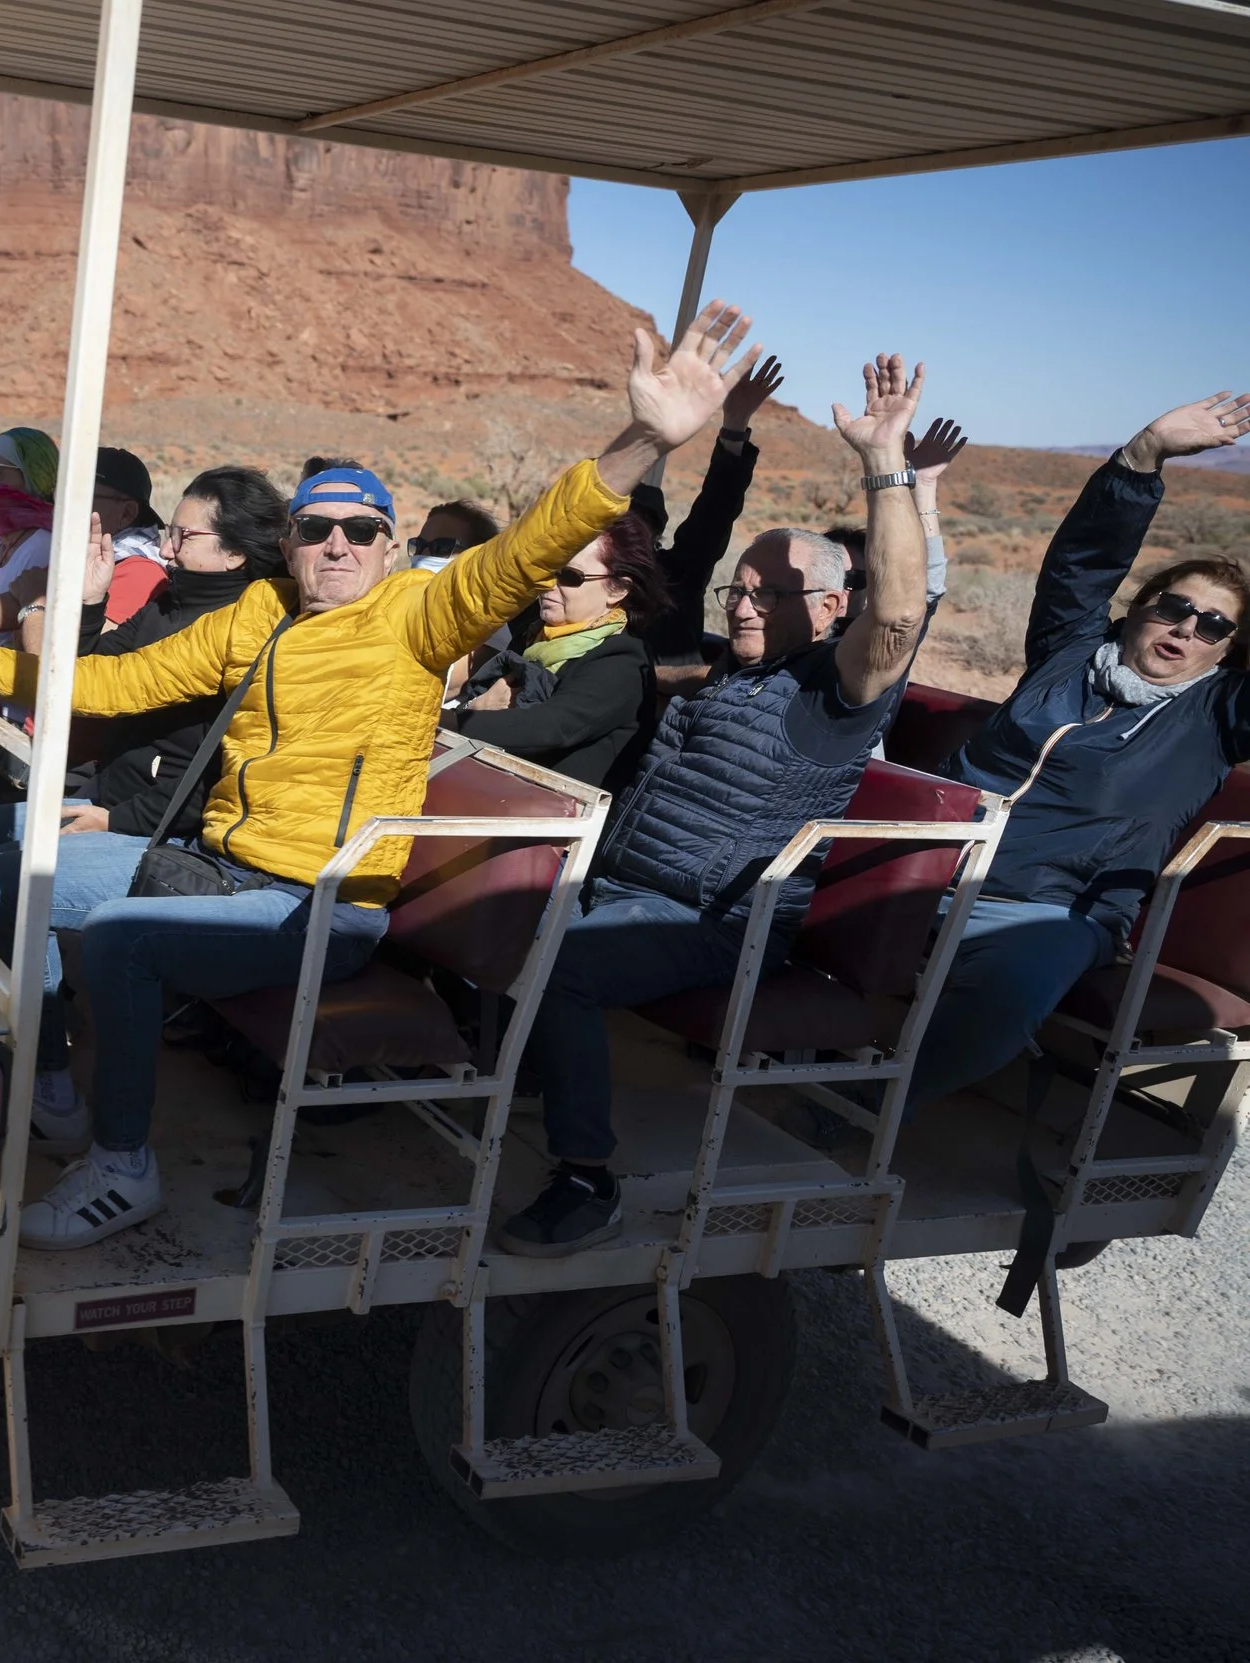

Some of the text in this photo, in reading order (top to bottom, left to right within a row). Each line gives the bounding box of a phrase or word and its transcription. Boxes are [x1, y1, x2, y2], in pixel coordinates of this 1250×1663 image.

[79, 1296, 193, 1321] WATCH YOUR STEP
